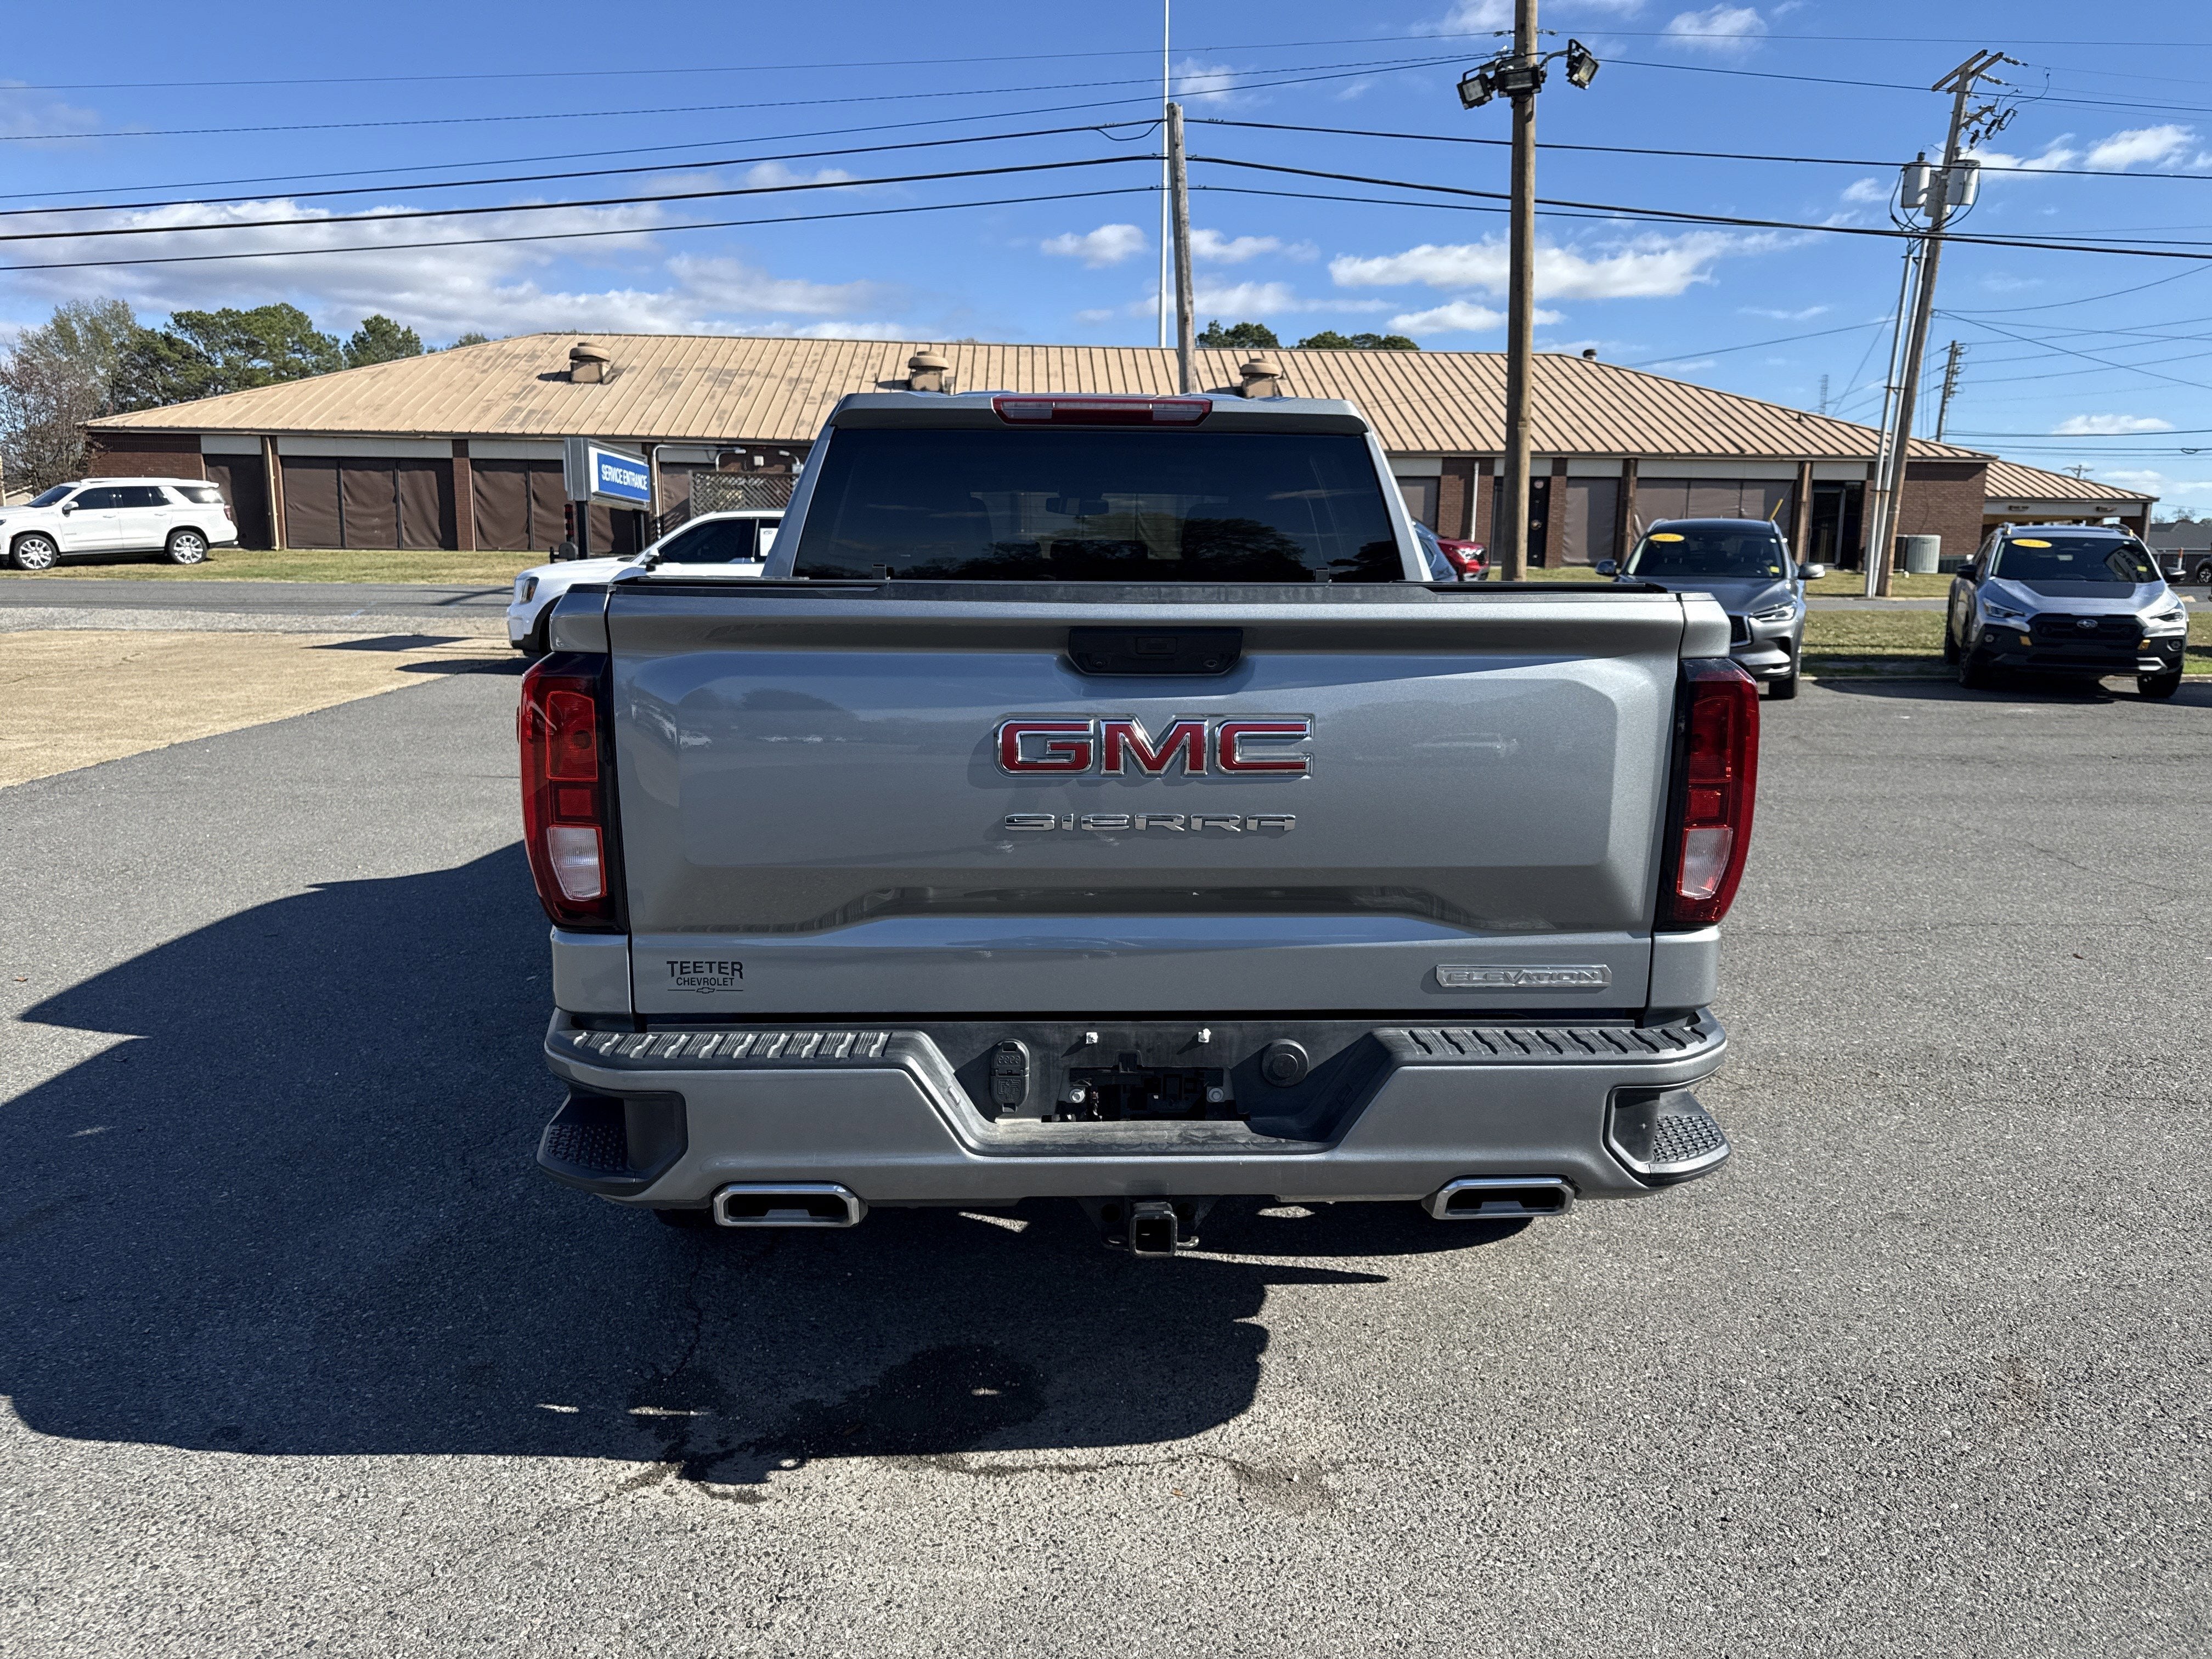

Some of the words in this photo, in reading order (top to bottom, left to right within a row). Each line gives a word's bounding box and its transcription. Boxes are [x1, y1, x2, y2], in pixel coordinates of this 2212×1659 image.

[601, 464, 623, 484] SERVICE
[623, 470, 648, 490] ENTRANCE
[996, 718, 1313, 778] GMC
[1005, 812, 1296, 832] SIERRA
[666, 961, 744, 979] TEETER
[1448, 970, 1600, 985] ELEVATION
[676, 977, 735, 986] CHEVROLET
